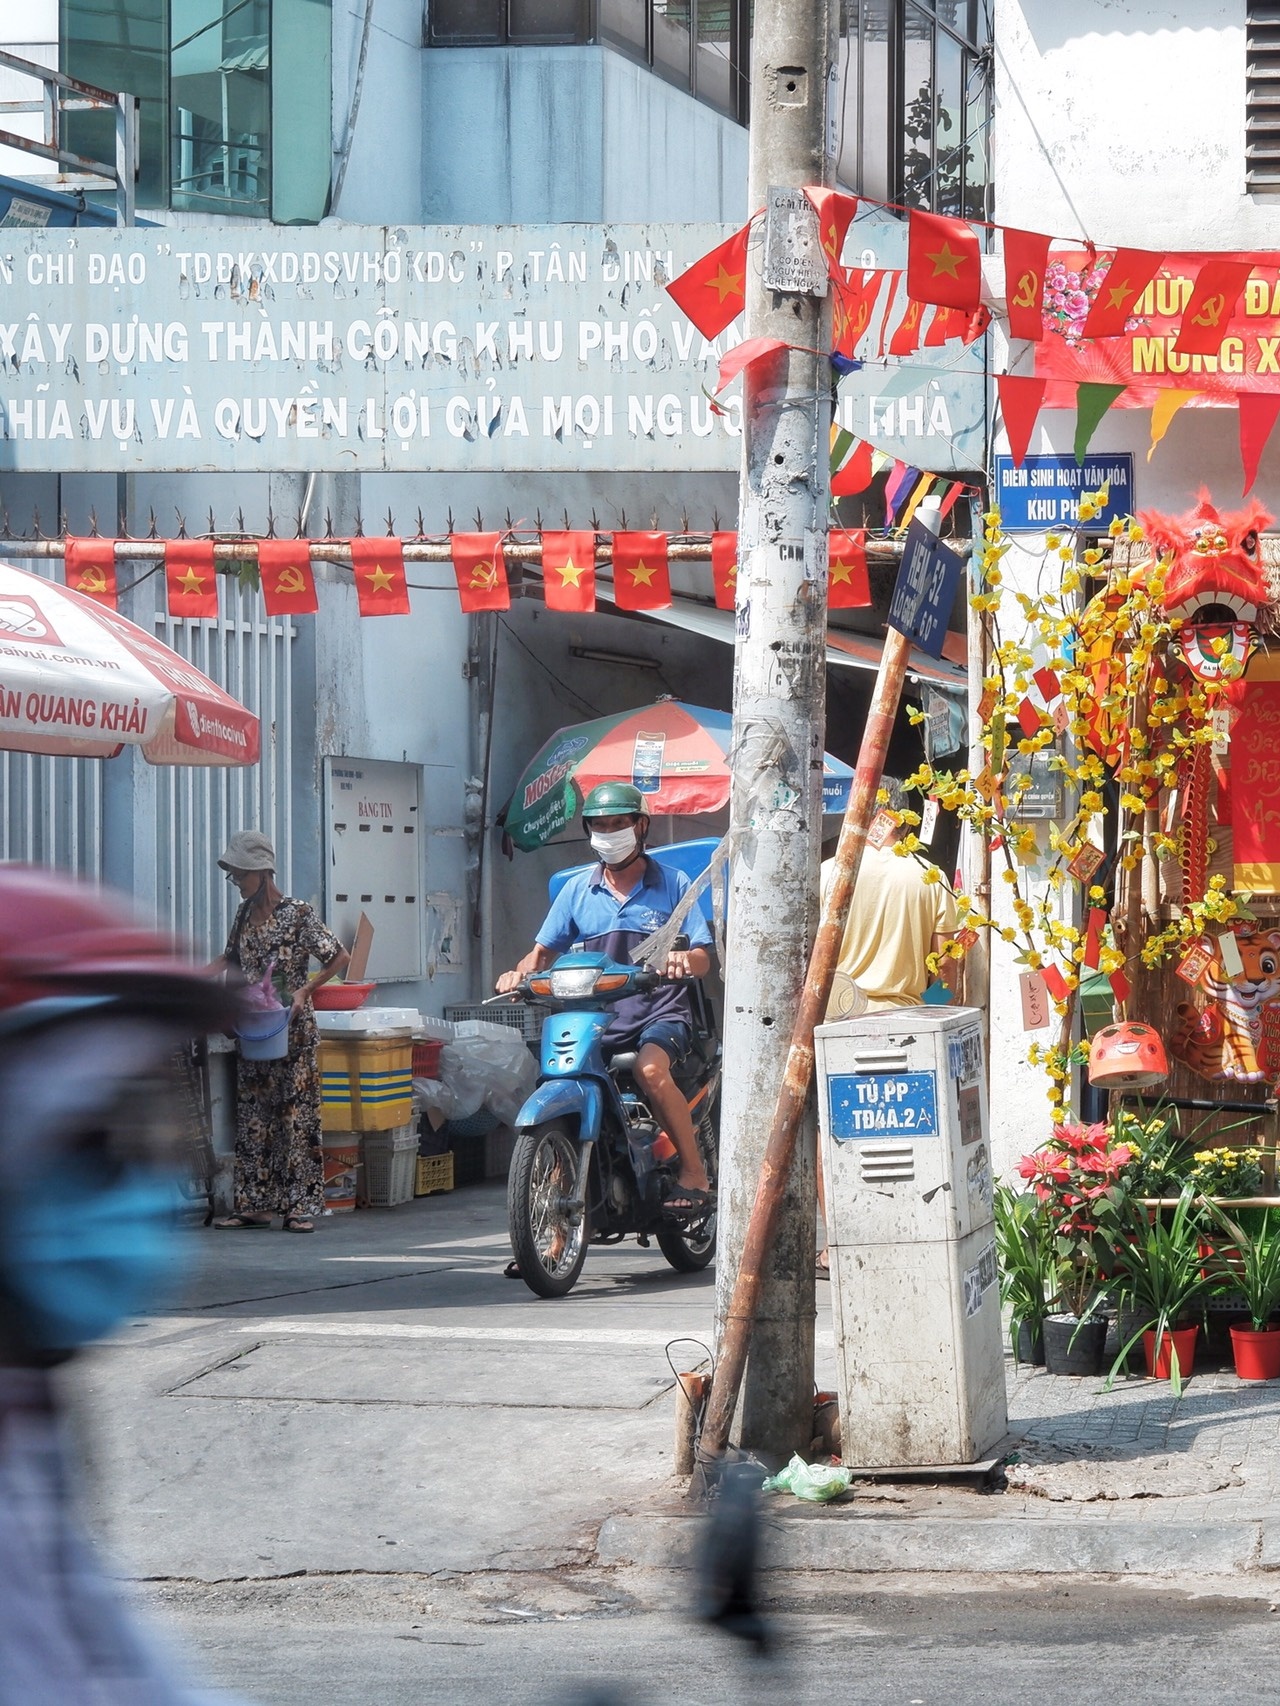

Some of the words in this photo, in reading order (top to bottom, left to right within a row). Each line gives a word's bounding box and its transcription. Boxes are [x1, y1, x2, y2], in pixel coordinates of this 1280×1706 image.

[27, 238, 76, 285] CHỈ
[88, 252, 147, 292] ĐẠO
[0, 313, 73, 363] XÂY
[86, 313, 189, 375] DỰNG
[202, 309, 333, 361] THÀNH
[346, 307, 457, 361] CÔNG
[476, 320, 564, 362] KHU
[578, 303, 663, 361] PHỐ
[84, 398, 135, 451] VỤ
[150, 385, 202, 439] VÀ
[214, 380, 347, 441] QUYỀN
[366, 388, 430, 451] LỢI
[445, 377, 530, 439] CỦA
[542, 395, 613, 449] MỌI
[868, 380, 953, 436] NHÀ
[1030, 468, 1055, 487] SINH
[1057, 468, 1082, 490] HOẠT
[1084, 465, 1105, 486] VĂN
[1107, 464, 1127, 486] HÓA
[1027, 499, 1056, 521] KHU
[26, 692, 97, 727] QUANG
[100, 697, 148, 734] KHẢI
[358, 795, 379, 818] BẢNG
[380, 802, 393, 818] TIN
[855, 1077, 878, 1104] TỦ
[884, 1081, 909, 1103] PP
